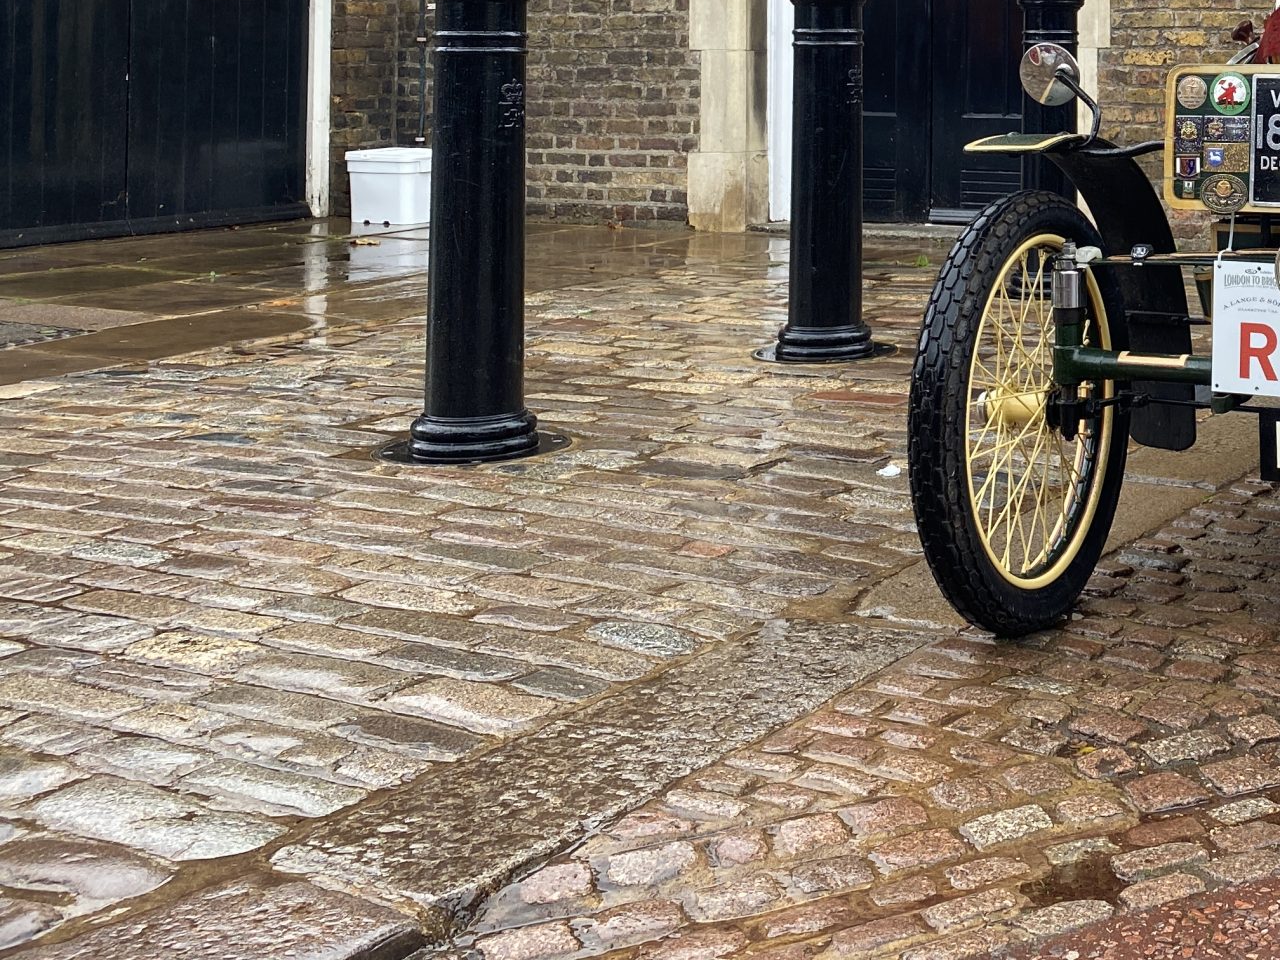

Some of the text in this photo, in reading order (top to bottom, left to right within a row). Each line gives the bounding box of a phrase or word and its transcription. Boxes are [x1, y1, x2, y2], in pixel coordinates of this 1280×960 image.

[1223, 274, 1277, 287] LONDON TO BRIG
[1230, 297, 1258, 306] LANGE
[1239, 322, 1278, 381] R
